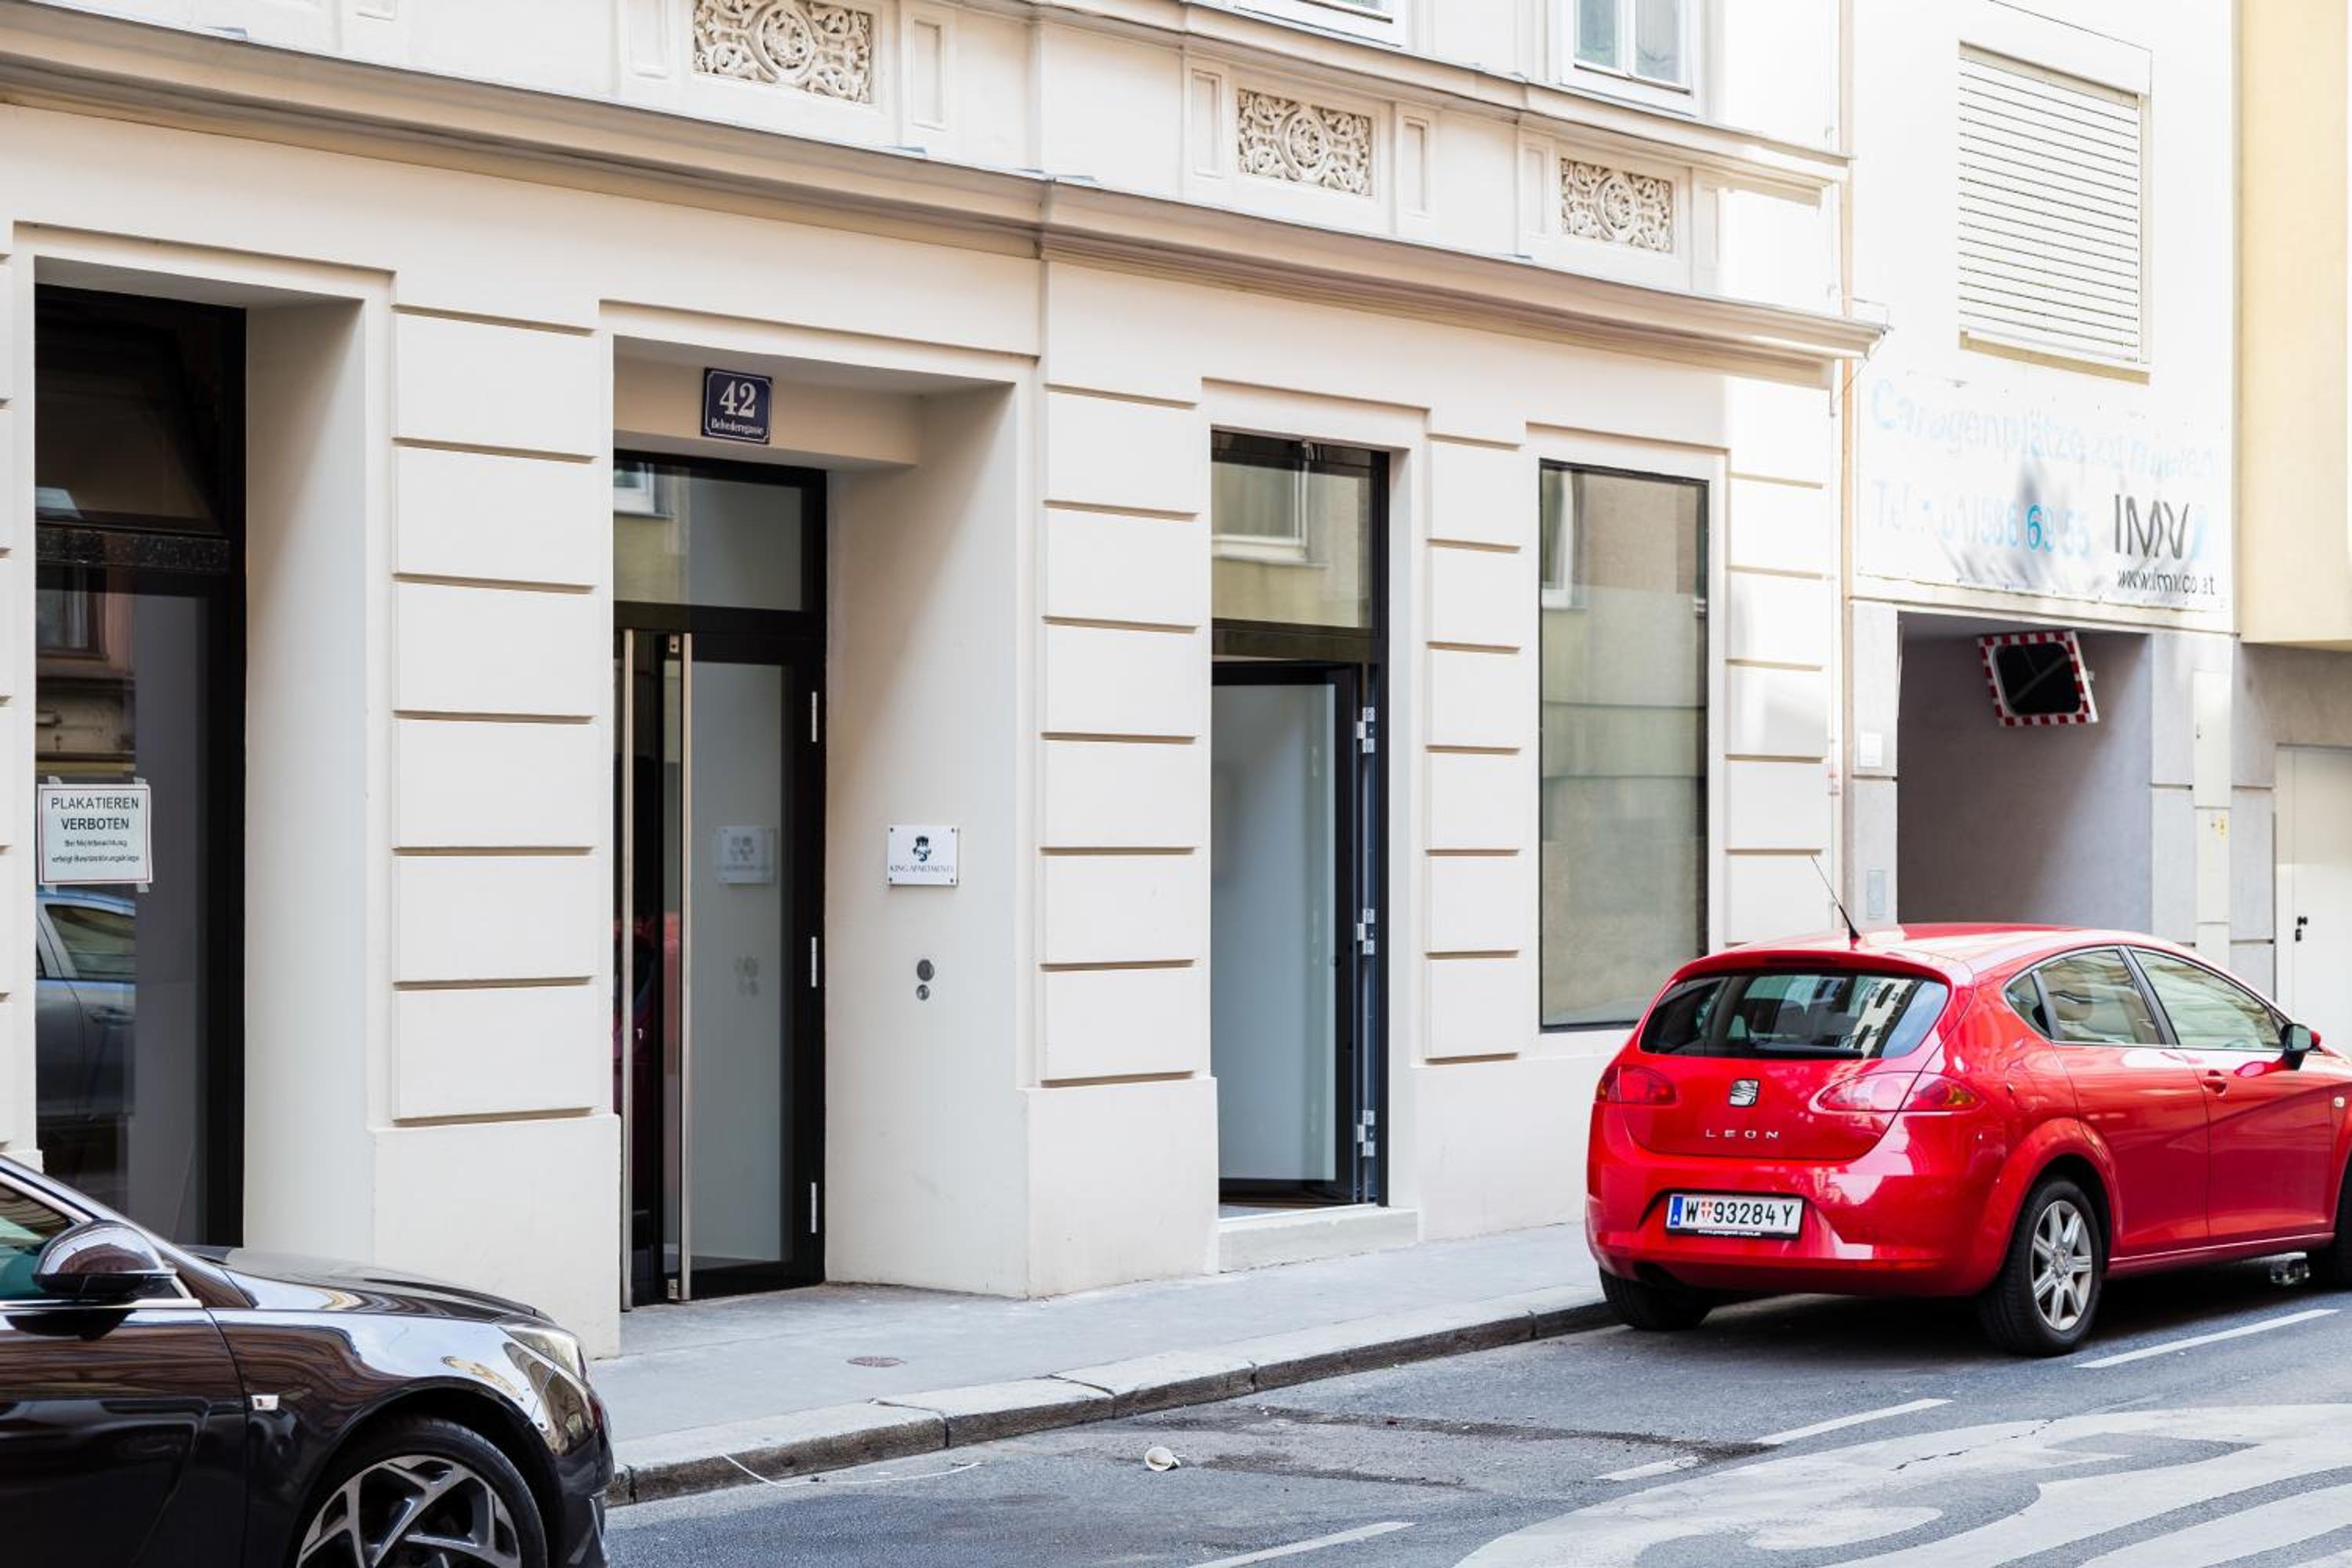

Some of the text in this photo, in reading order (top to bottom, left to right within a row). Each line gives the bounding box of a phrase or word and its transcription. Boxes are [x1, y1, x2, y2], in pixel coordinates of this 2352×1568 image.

[720, 380, 757, 418] 42
[51, 797, 139, 809] PLAKATIEREN
[61, 818, 129, 829] VERBOTEN
[1705, 1128, 1780, 1139] LEON
[1685, 1202, 1795, 1226] W 93284 Y
